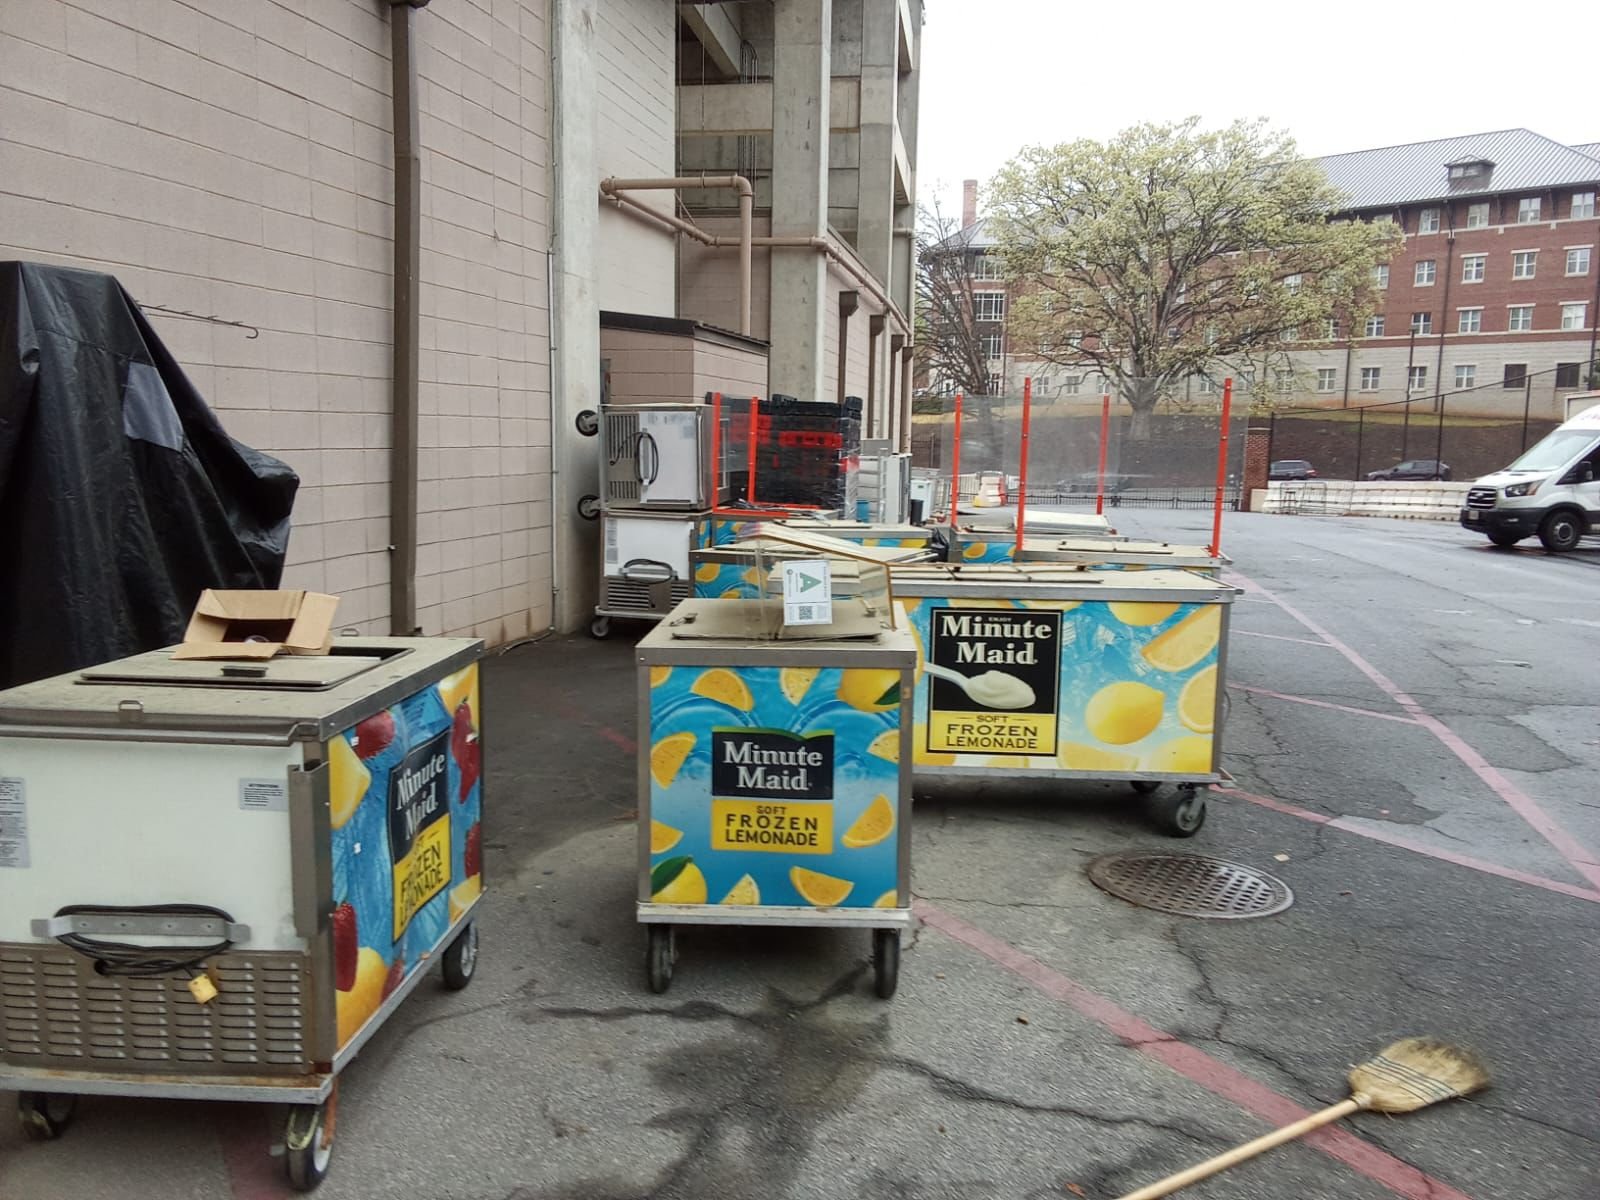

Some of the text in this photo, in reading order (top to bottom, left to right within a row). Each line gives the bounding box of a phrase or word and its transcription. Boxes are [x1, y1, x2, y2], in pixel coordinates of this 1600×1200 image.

[940, 615, 1052, 639] Minute
[955, 641, 1036, 665] Maid
[947, 723, 1038, 737] FROZEN
[976, 714, 1009, 723] SOFT
[722, 740, 823, 767] Minute
[945, 735, 1038, 749] LEMONADE
[396, 754, 445, 810] Minute
[736, 766, 809, 791] Maid
[756, 804, 787, 815] SOFT
[725, 813, 818, 831] FROZEN
[725, 829, 818, 847] LEMONADE
[401, 841, 441, 904] FZEN
[400, 862, 443, 926] LNADE
